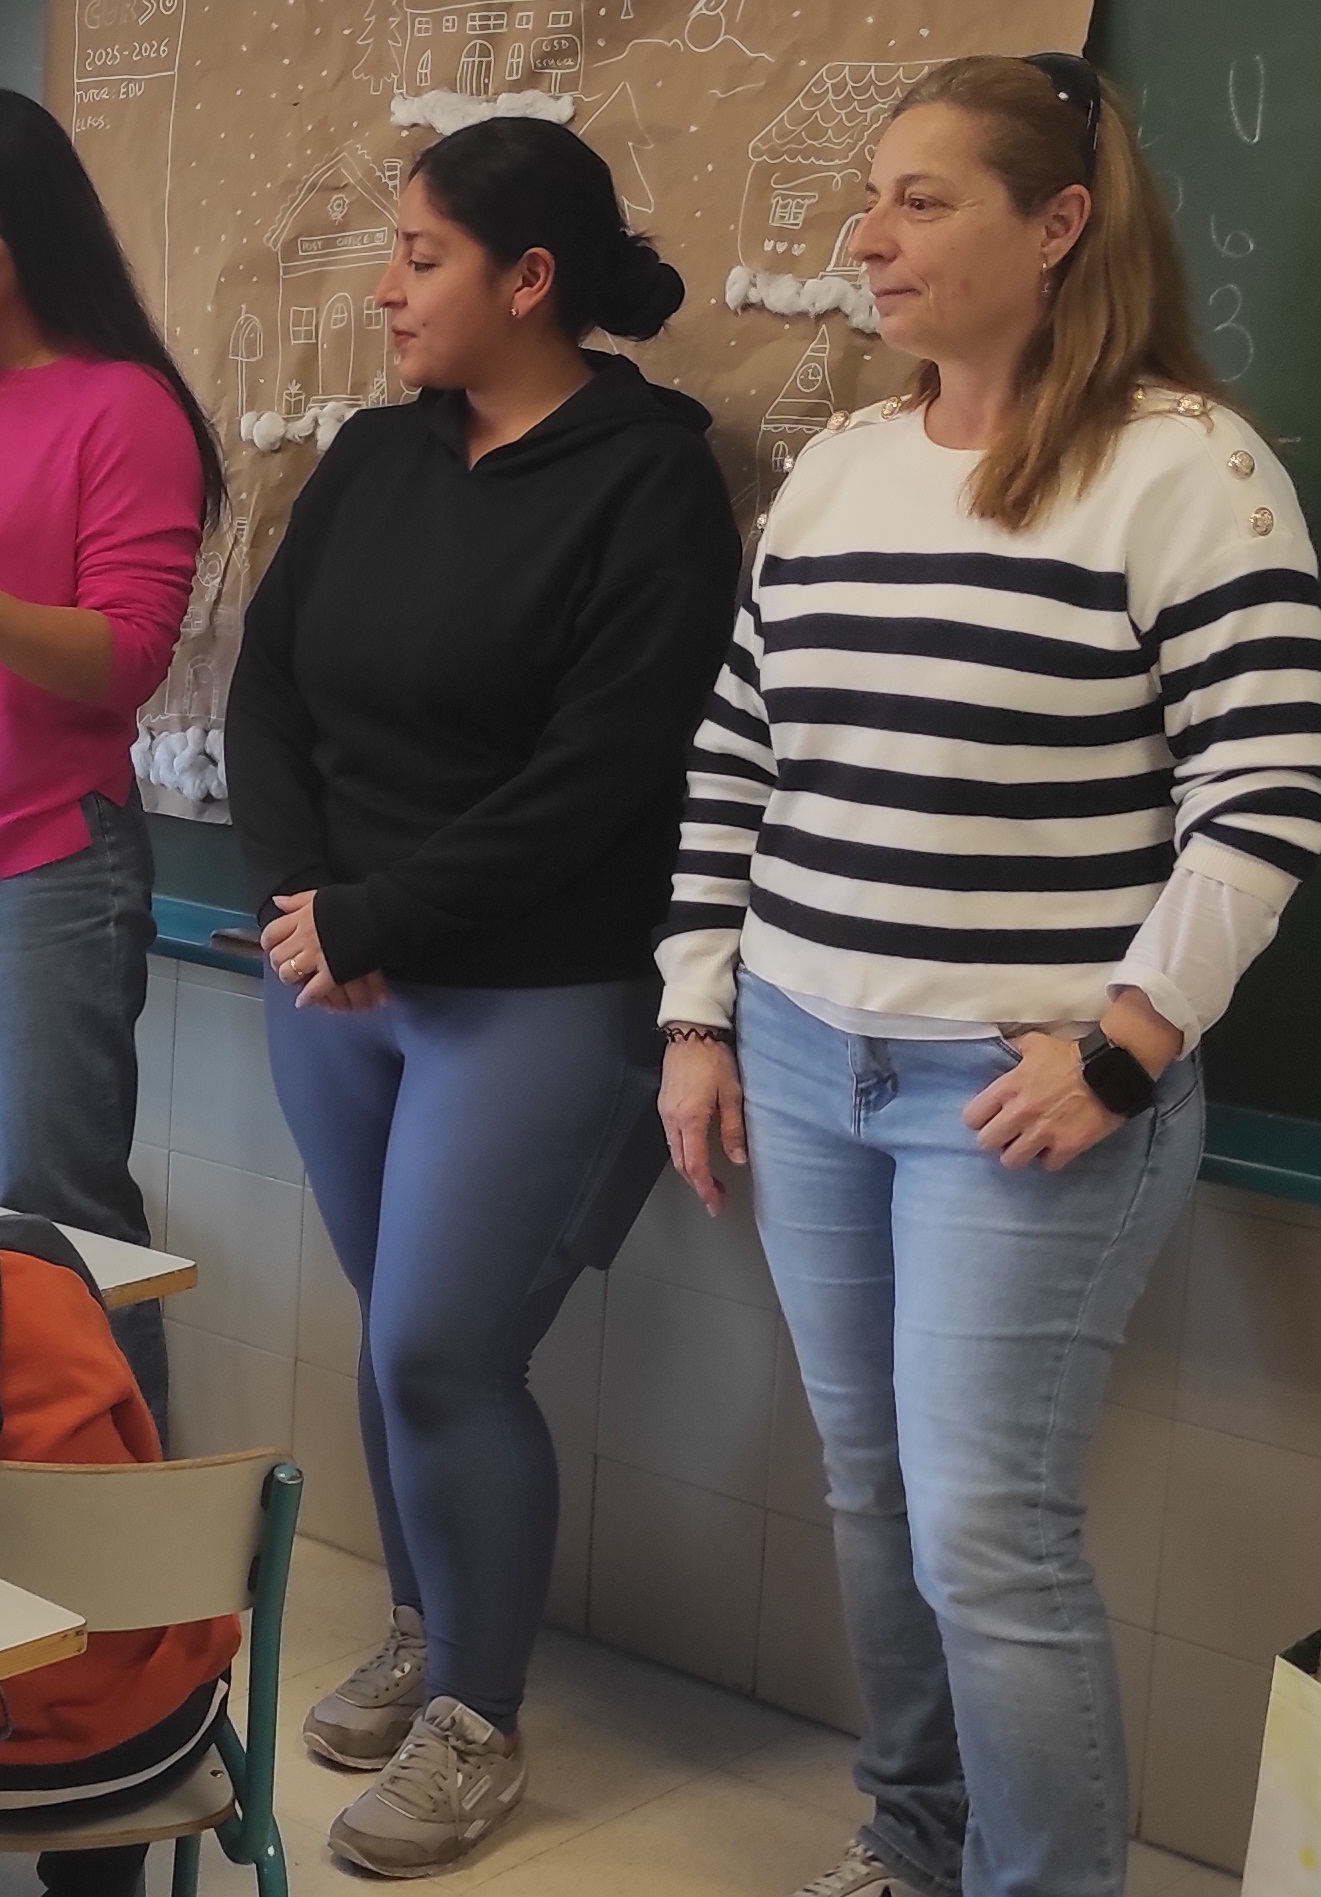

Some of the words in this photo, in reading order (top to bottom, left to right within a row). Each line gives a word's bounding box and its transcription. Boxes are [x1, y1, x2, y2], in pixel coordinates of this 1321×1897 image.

[85, 37, 170, 71] 2025-2026
[119, 81, 145, 99] EDU
[1210, 212, 1255, 258] 6
[1209, 283, 1255, 382] 3
